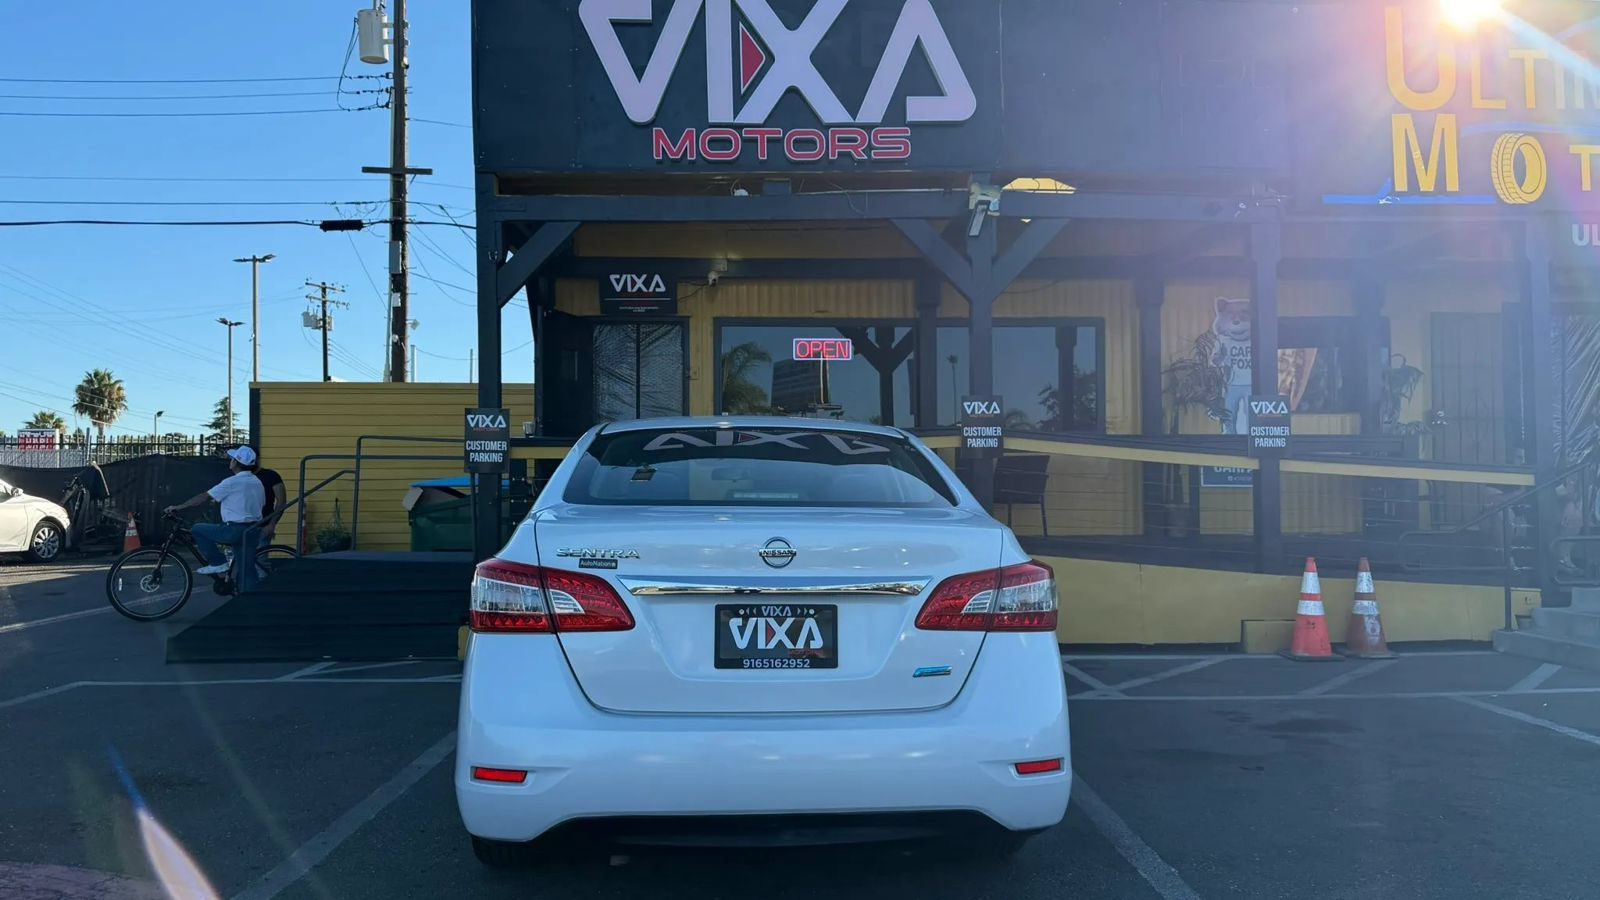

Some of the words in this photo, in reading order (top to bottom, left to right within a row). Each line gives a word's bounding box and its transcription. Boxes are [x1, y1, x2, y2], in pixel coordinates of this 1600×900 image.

[579, 0, 976, 124] VIXA
[652, 127, 912, 161] MOTORS
[609, 274, 666, 293] VIXA
[796, 341, 848, 358] OPEN
[963, 401, 1001, 414] VIXA
[1250, 401, 1289, 414] VIXA
[466, 415, 507, 428] VIXA
[963, 426, 1002, 437] CUSTOMER
[1250, 426, 1290, 436] CUSTOMER
[466, 440, 508, 451] CUSTOMER
[967, 438, 999, 448] PARKING
[1254, 437, 1286, 448] PARKING
[469, 452, 503, 463] PARKING
[556, 547, 641, 559] SENTRA
[763, 549, 794, 557] NISSAN
[580, 560, 612, 568] AutoNation
[762, 606, 793, 617] VIXA
[729, 617, 825, 650] VIXA
[743, 659, 811, 669] 9165162952
